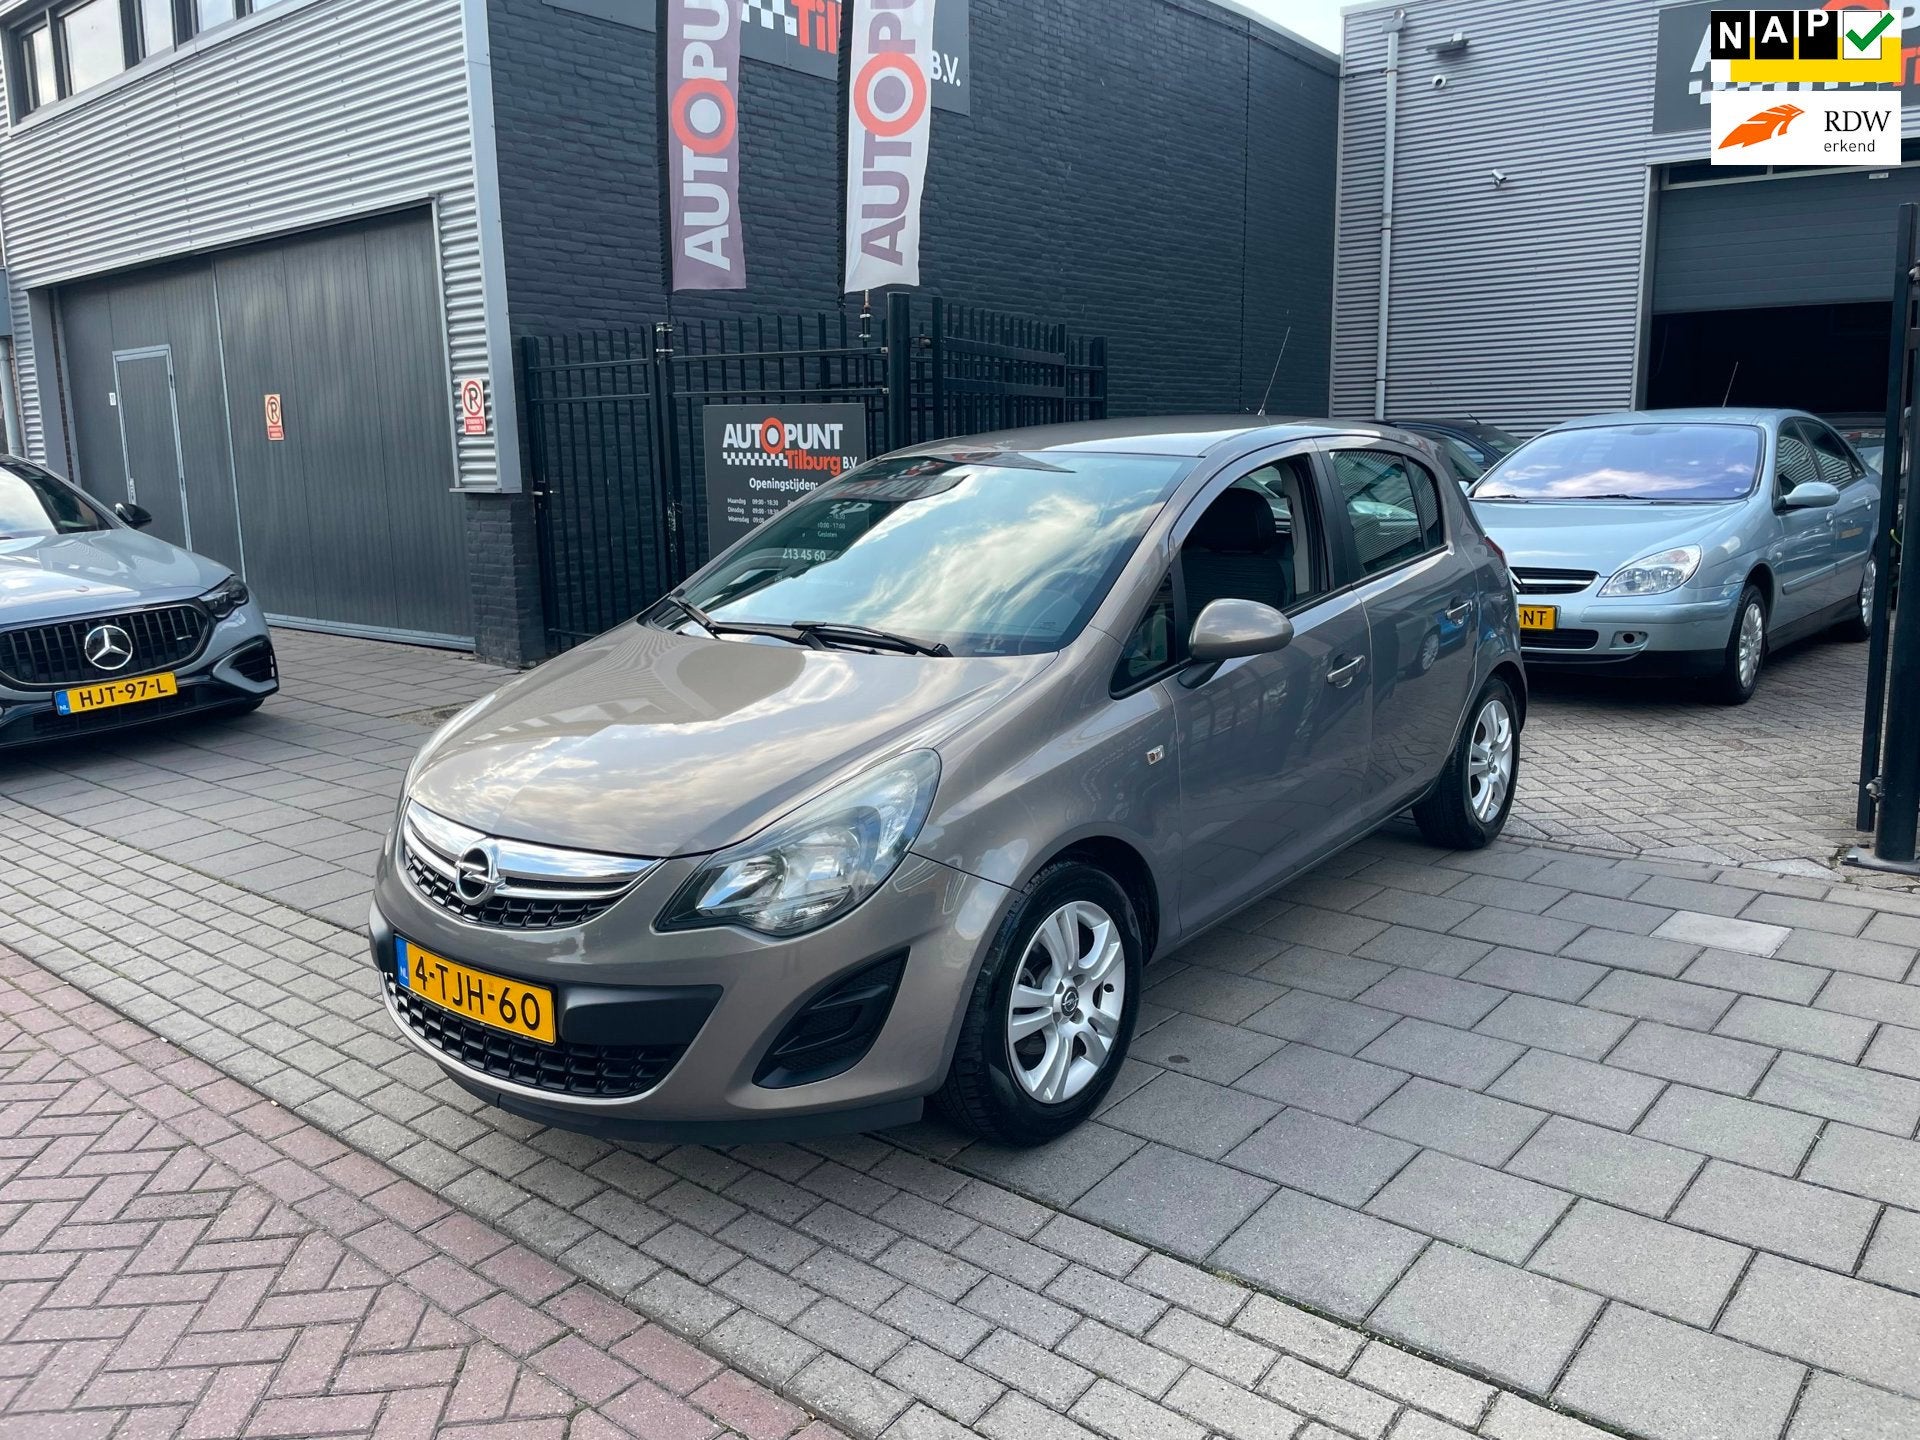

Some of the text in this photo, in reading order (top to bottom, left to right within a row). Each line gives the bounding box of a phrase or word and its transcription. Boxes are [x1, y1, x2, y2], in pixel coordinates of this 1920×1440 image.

[722, 417, 843, 454] AUTOPUNT
[785, 450, 841, 476] Tilburg
[727, 497, 747, 505] Maandag
[728, 506, 745, 514] Dinsdag
[728, 516, 750, 524] Woensdag
[801, 548, 812, 561] 45
[814, 550, 826, 561] 60
[79, 679, 168, 708] HJT-97-L
[415, 955, 541, 1031] 4-TJH-60
